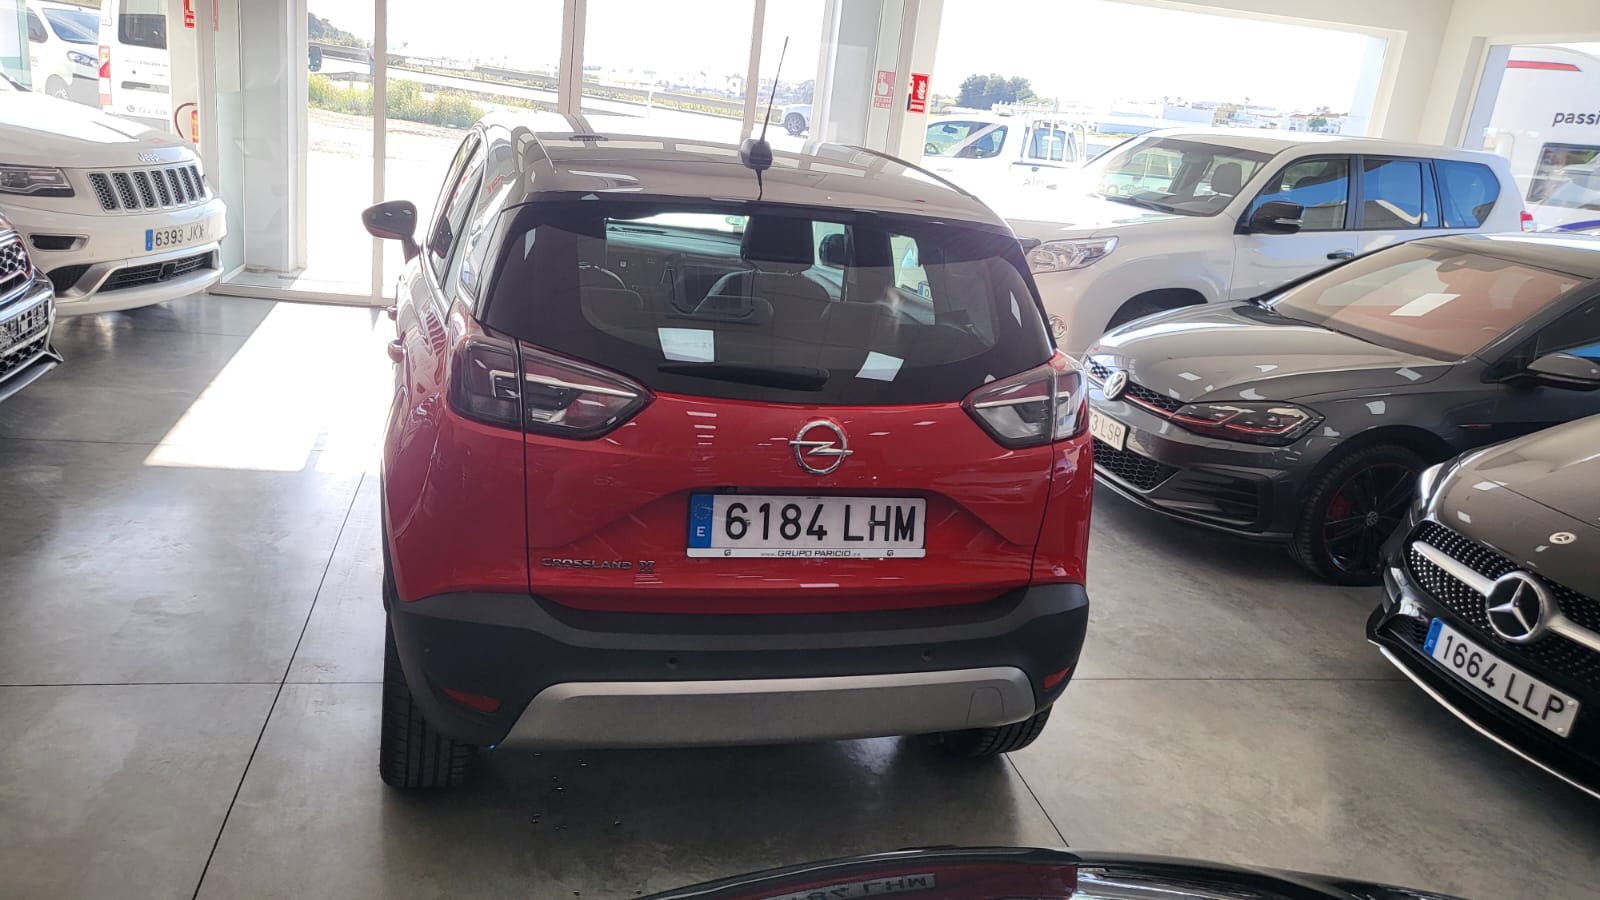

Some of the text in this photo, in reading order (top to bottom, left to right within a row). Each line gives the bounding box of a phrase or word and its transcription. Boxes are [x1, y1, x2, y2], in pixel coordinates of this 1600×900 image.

[155, 228, 184, 247] 6393
[1100, 417, 1122, 446] LSR
[696, 526, 706, 537] E
[725, 502, 916, 542] 6184 LHM
[777, 549, 812, 557] GRUPO
[814, 549, 851, 557] PARICIO
[541, 557, 656, 573] CROSSLAND X
[1441, 634, 1565, 721] 1664 LLP
